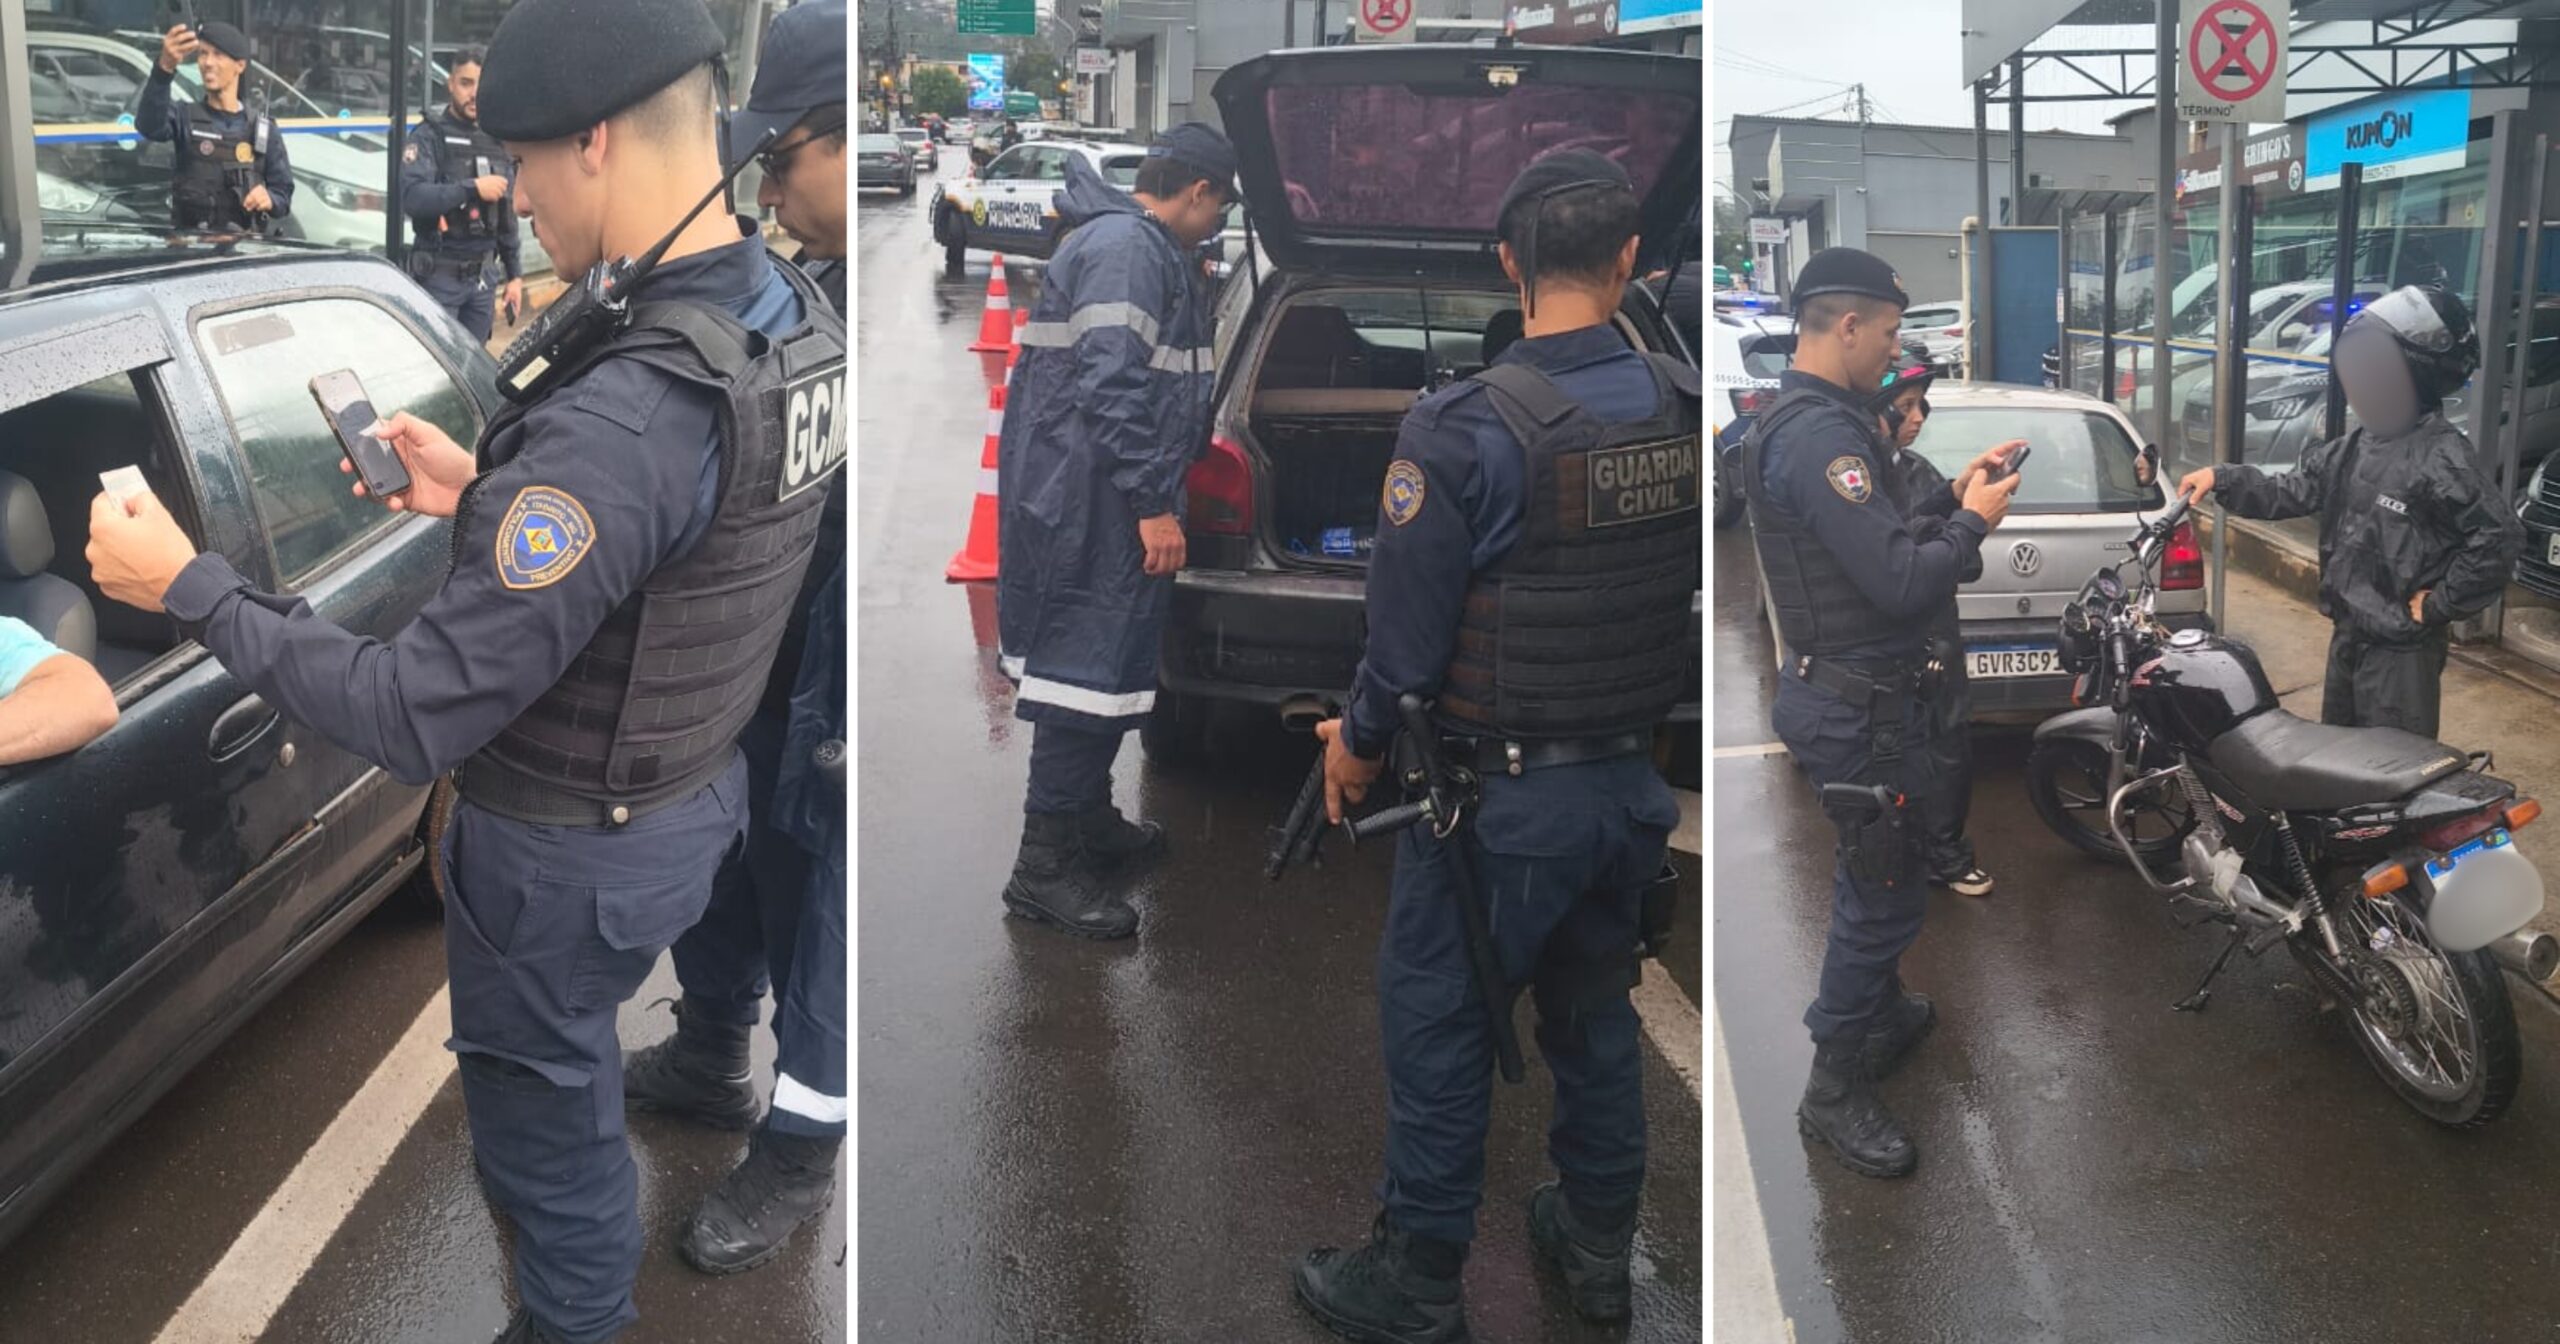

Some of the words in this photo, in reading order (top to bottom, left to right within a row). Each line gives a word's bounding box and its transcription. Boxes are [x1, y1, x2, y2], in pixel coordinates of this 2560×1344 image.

[2346, 110, 2414, 150] KUMON
[988, 211, 1043, 231] MUNICIPAL
[1594, 443, 1694, 491] GUARDA
[1617, 483, 1680, 515] CIVIL
